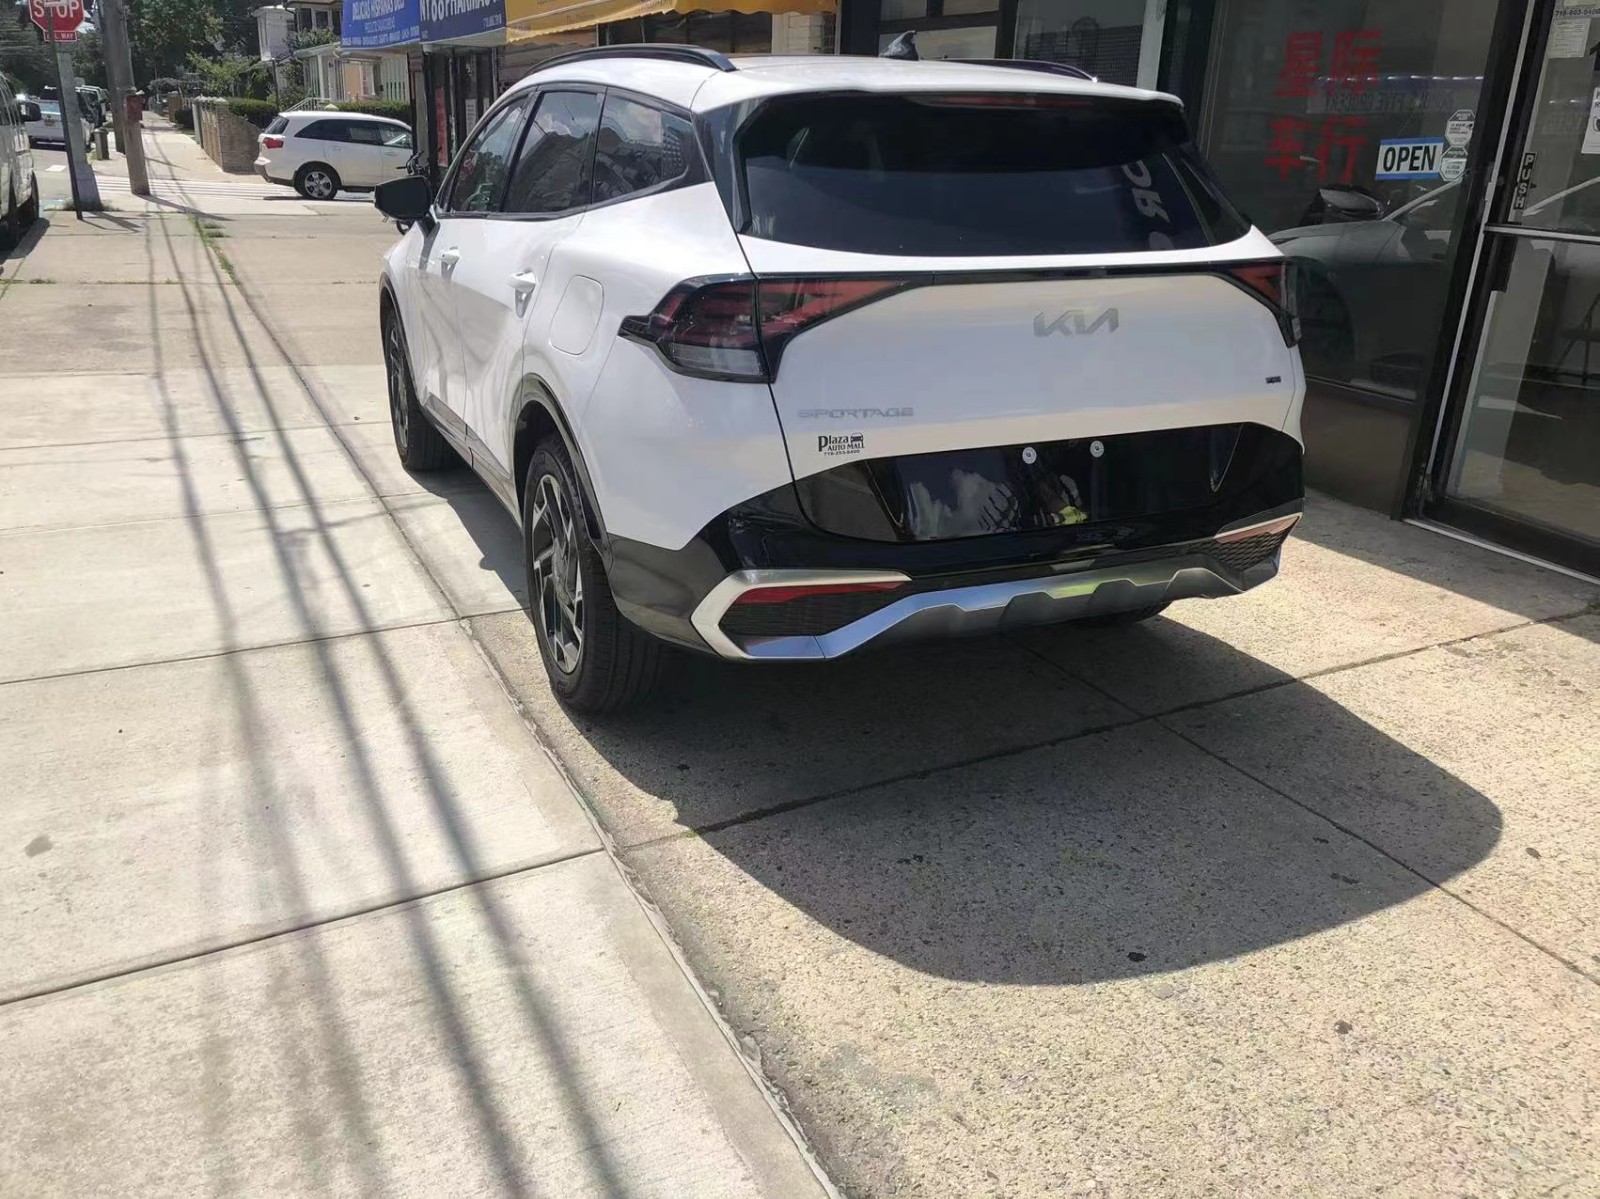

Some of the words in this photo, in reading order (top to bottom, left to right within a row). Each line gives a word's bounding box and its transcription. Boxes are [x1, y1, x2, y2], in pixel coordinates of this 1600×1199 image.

[1383, 145, 1437, 172] OPEN
[1515, 154, 1535, 208] PUSH
[1033, 308, 1119, 336] KIA
[798, 407, 914, 418] SPORTAGE
[818, 434, 849, 452] Plaza
[827, 444, 846, 452] AUTO
[847, 441, 865, 449] MALL
